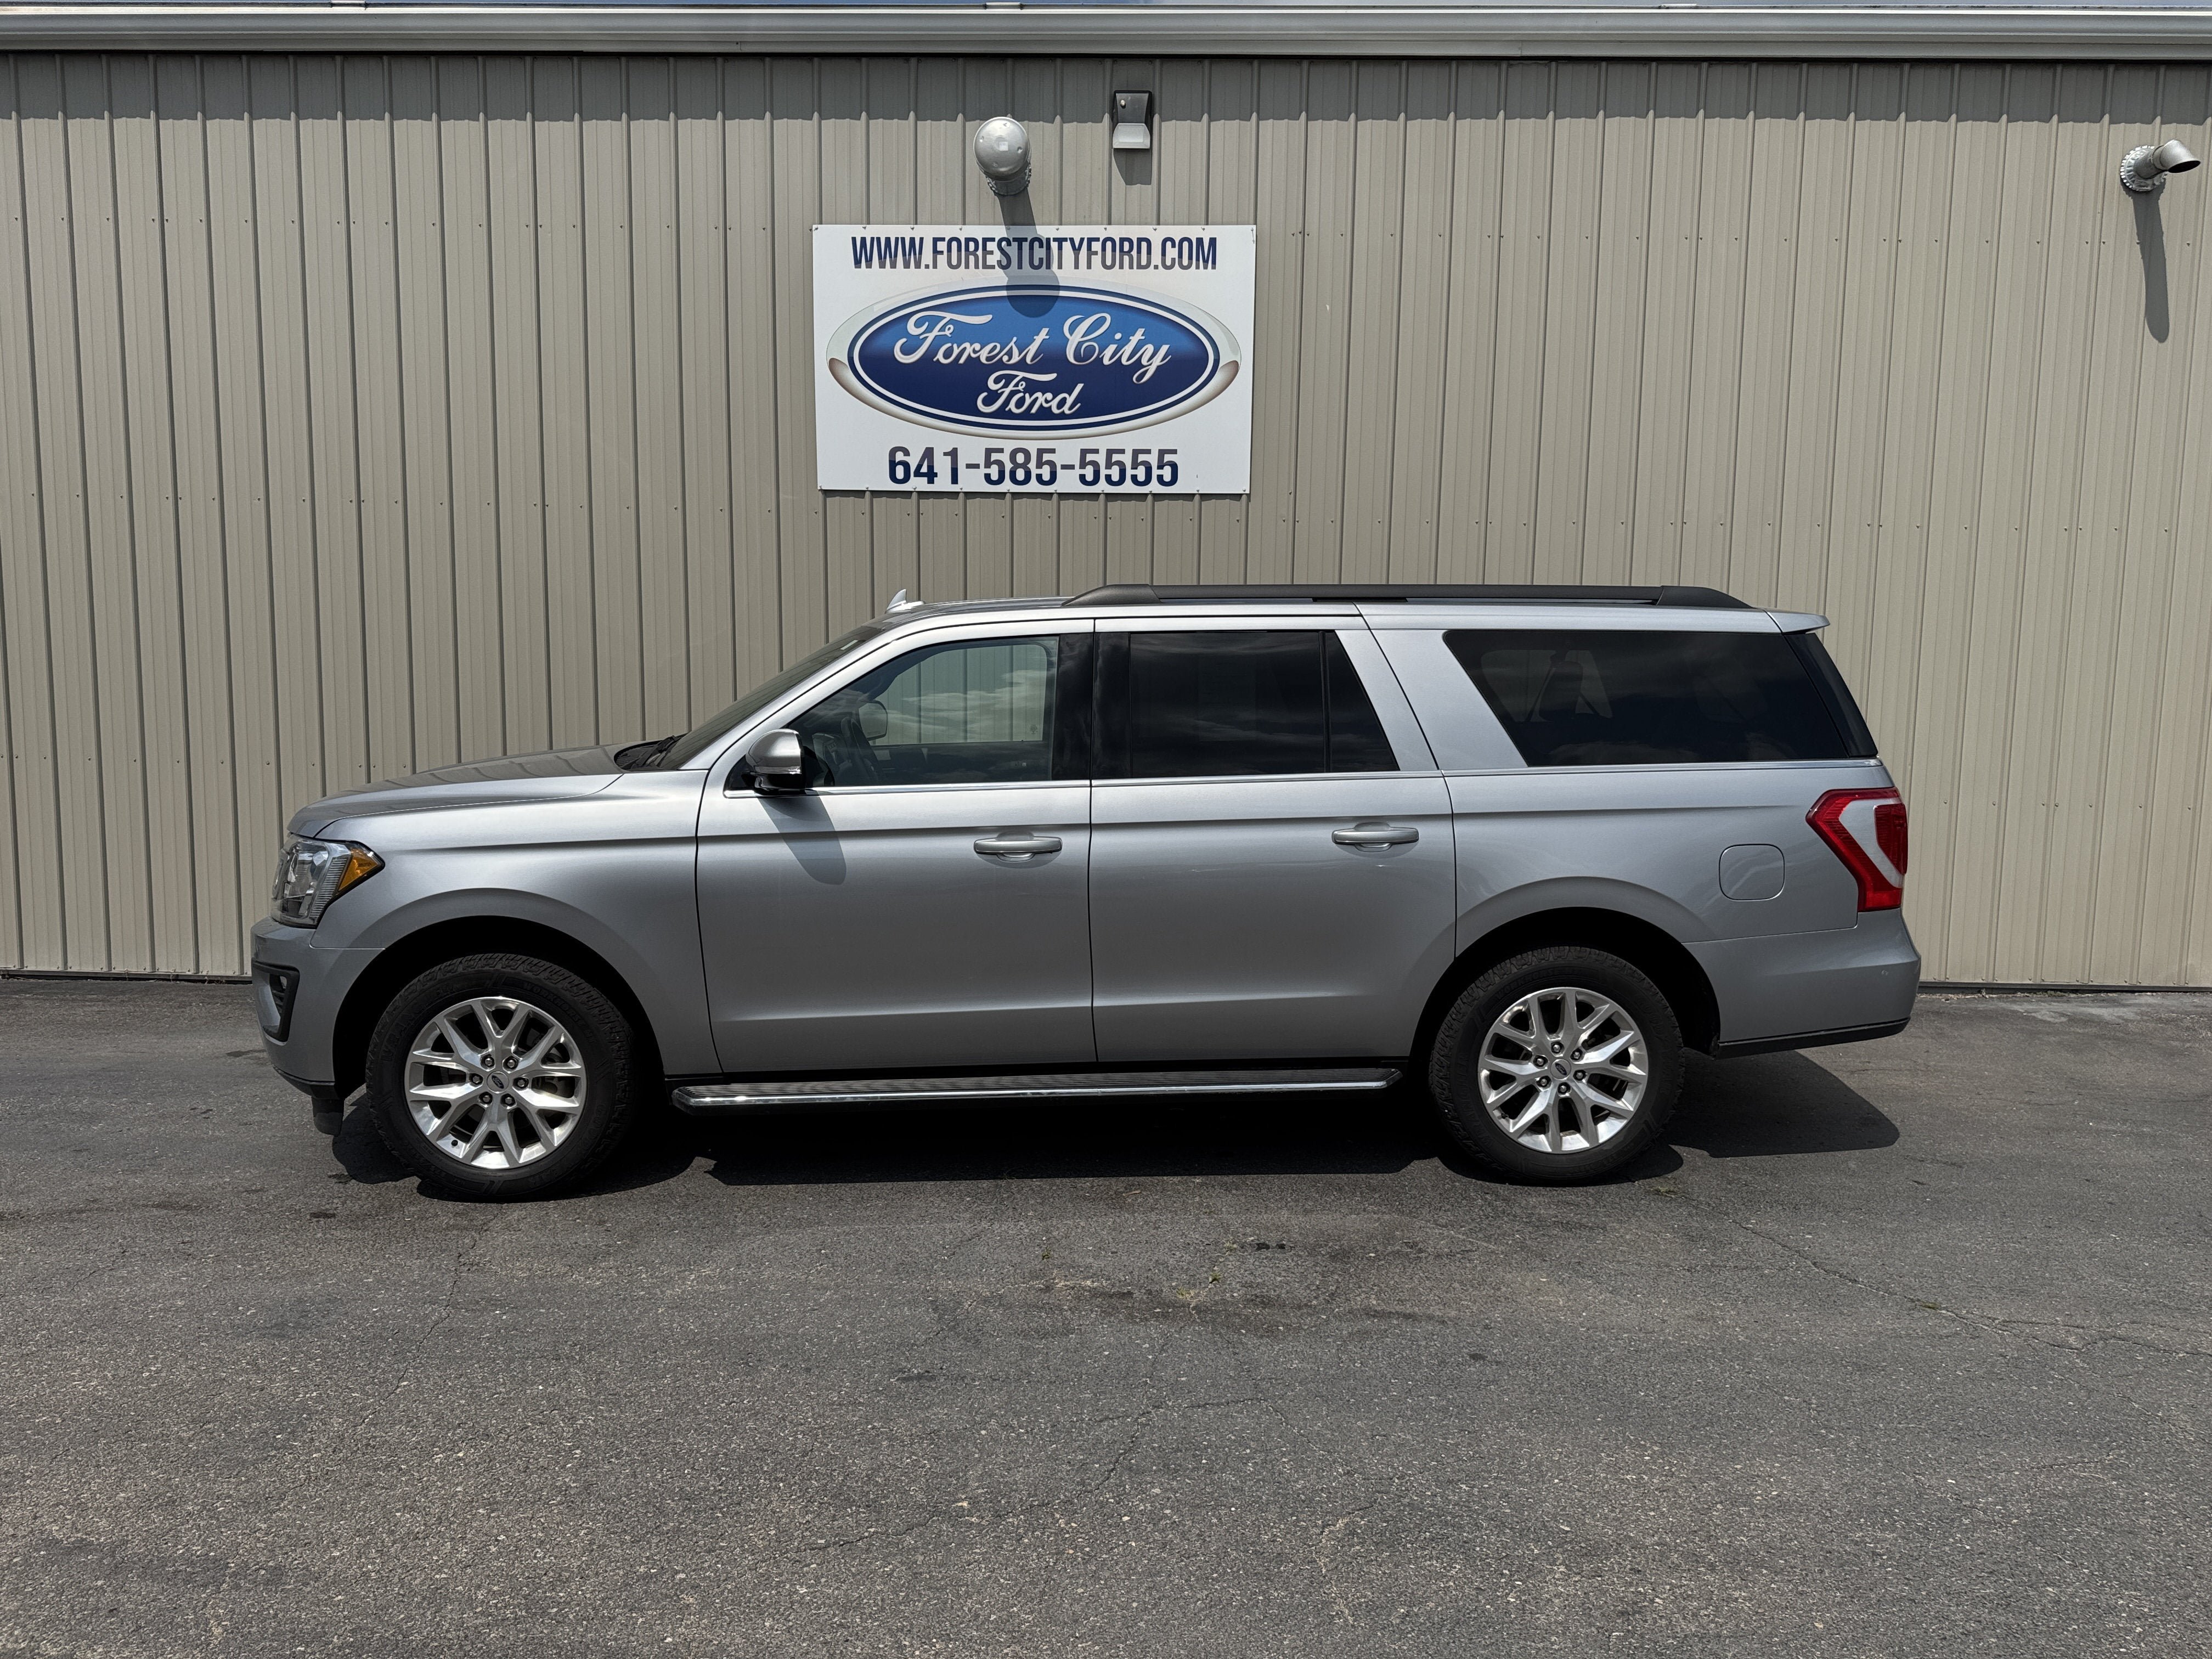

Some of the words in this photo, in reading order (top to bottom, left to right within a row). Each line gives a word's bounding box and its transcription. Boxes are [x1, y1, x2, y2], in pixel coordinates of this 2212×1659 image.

[851, 236, 1217, 270] WWW.FORESTCITYFORD.COM
[893, 310, 1050, 365] Forest
[1063, 312, 1172, 385] City
[976, 370, 1085, 415] Ford
[888, 445, 1179, 487] 641-585-5555
